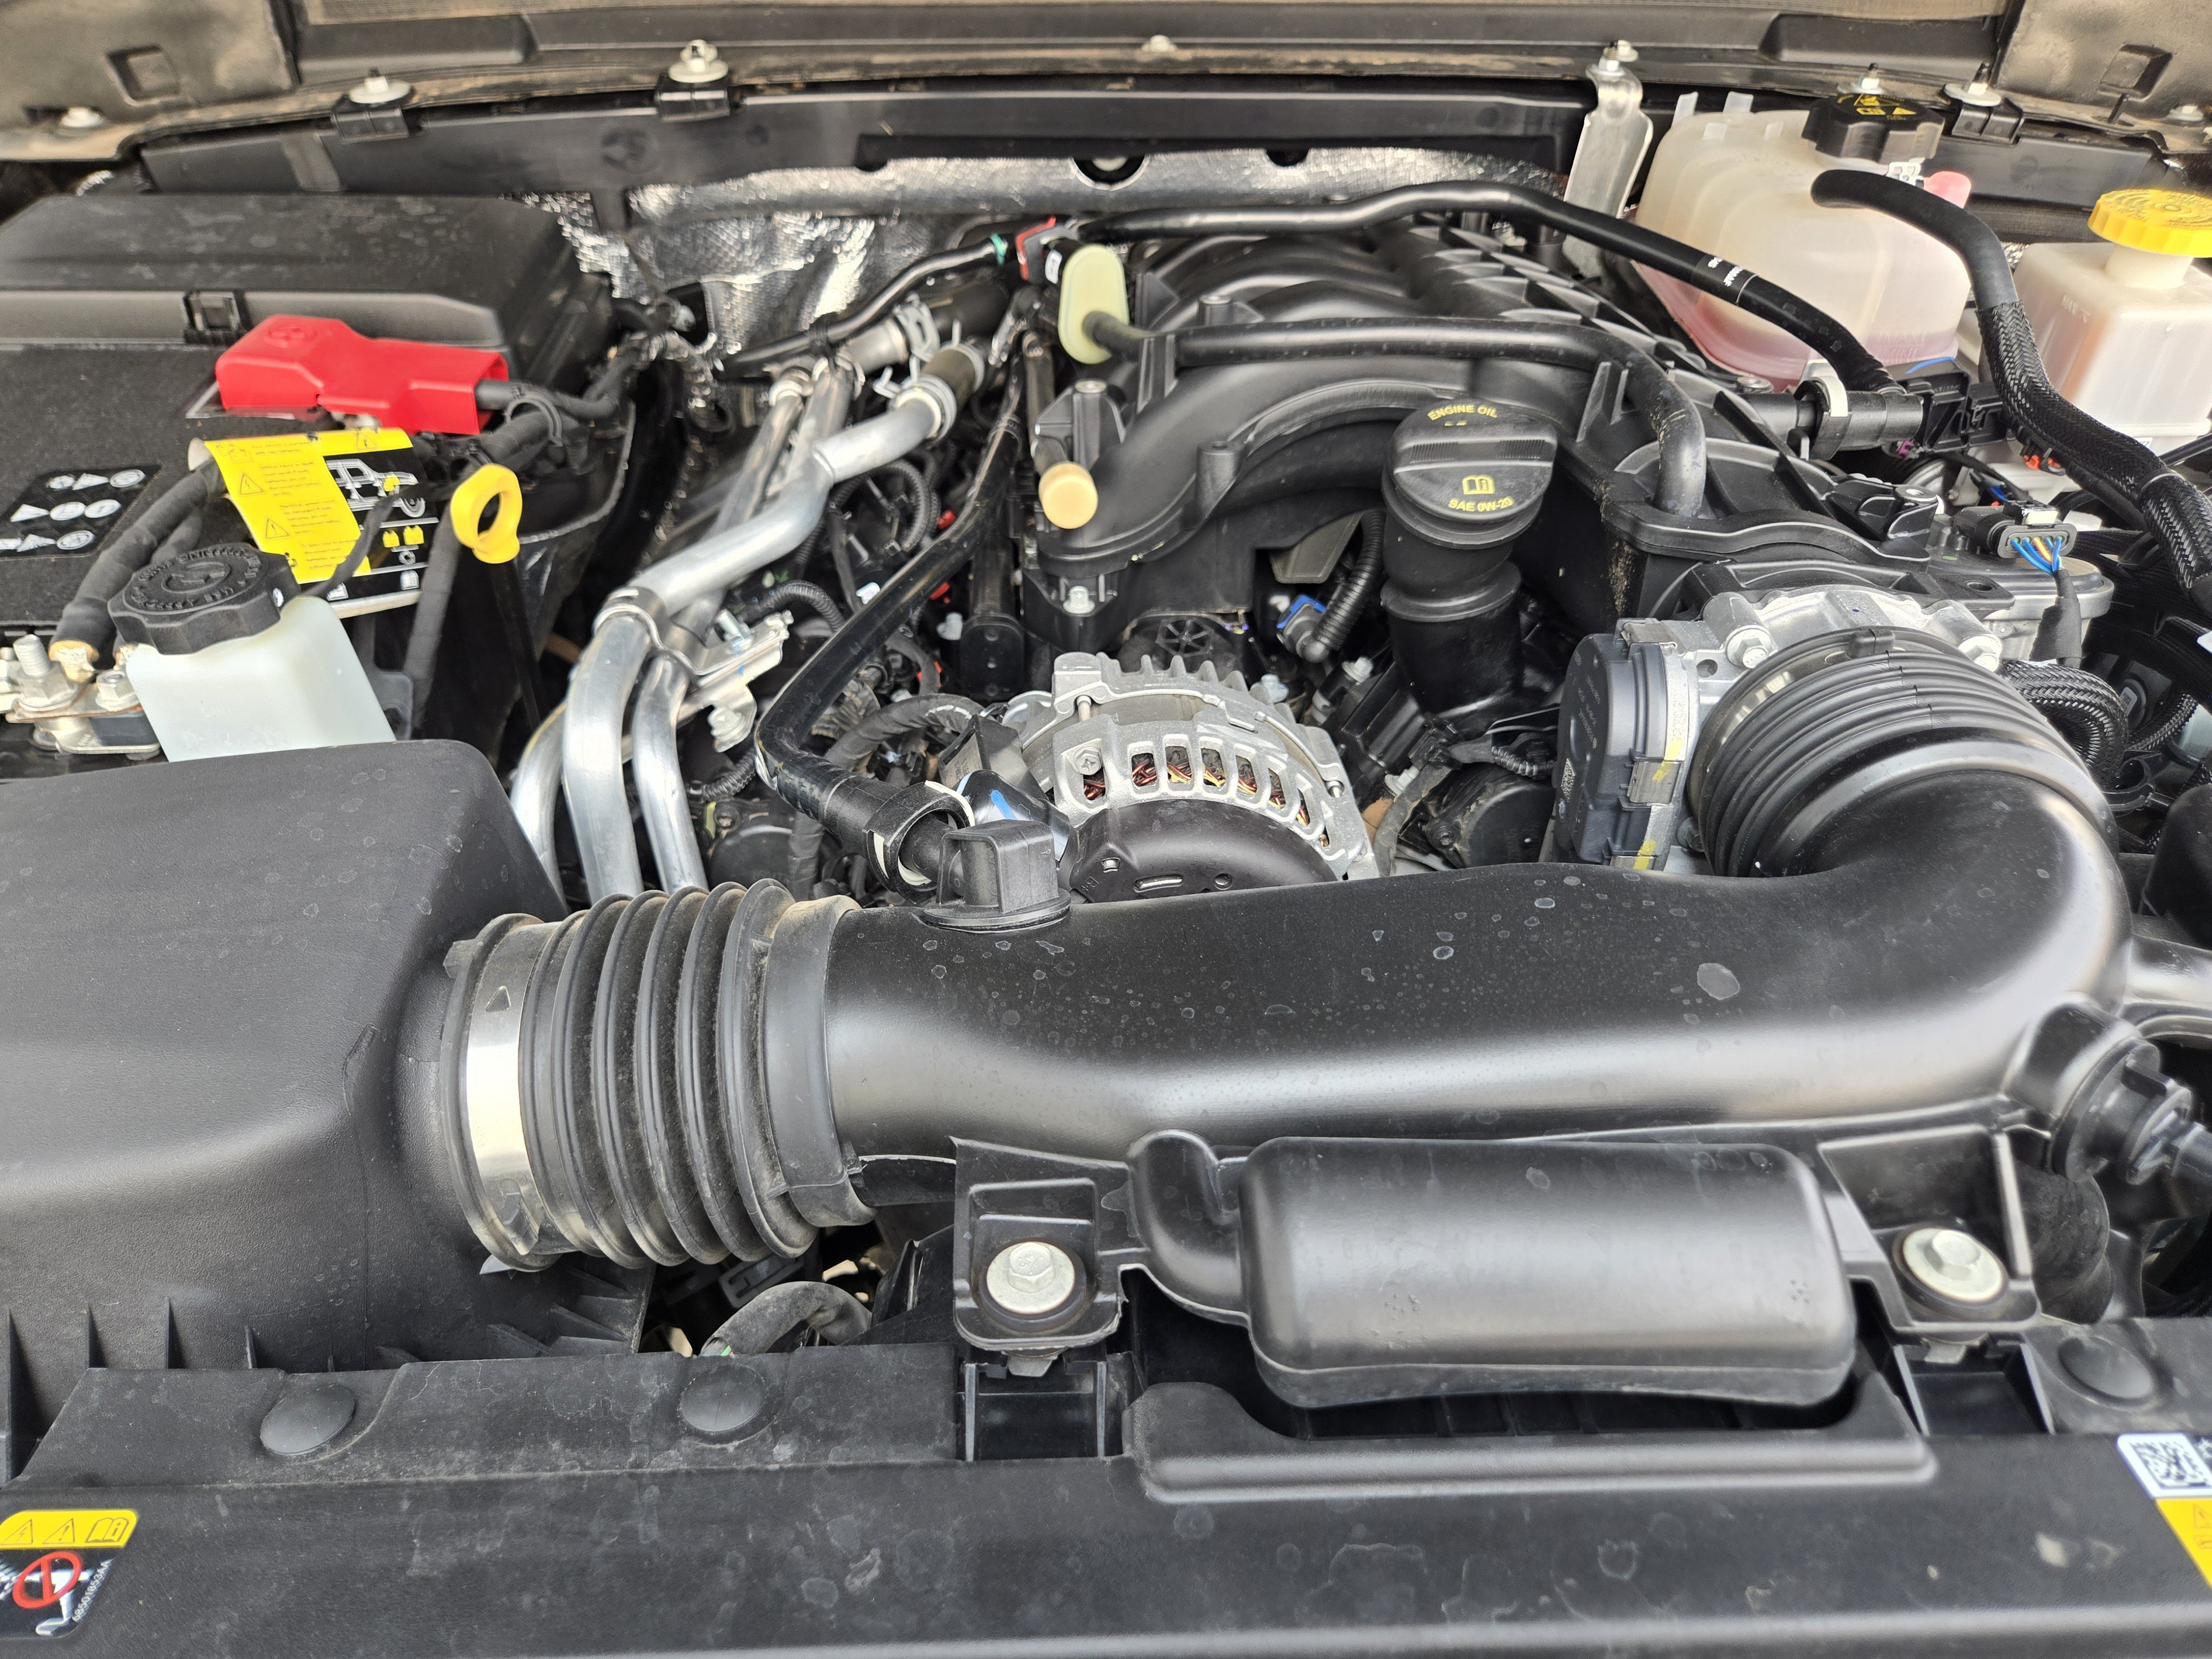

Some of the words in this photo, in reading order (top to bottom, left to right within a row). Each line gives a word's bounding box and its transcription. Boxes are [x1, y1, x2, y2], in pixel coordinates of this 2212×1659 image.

[1427, 404, 1475, 421] ENGINE
[1478, 404, 1498, 418] OIL
[1448, 498, 1475, 512] SAE
[1477, 496, 1515, 512] 0W-20
[72, 1559, 111, 1623] 68501853AA
